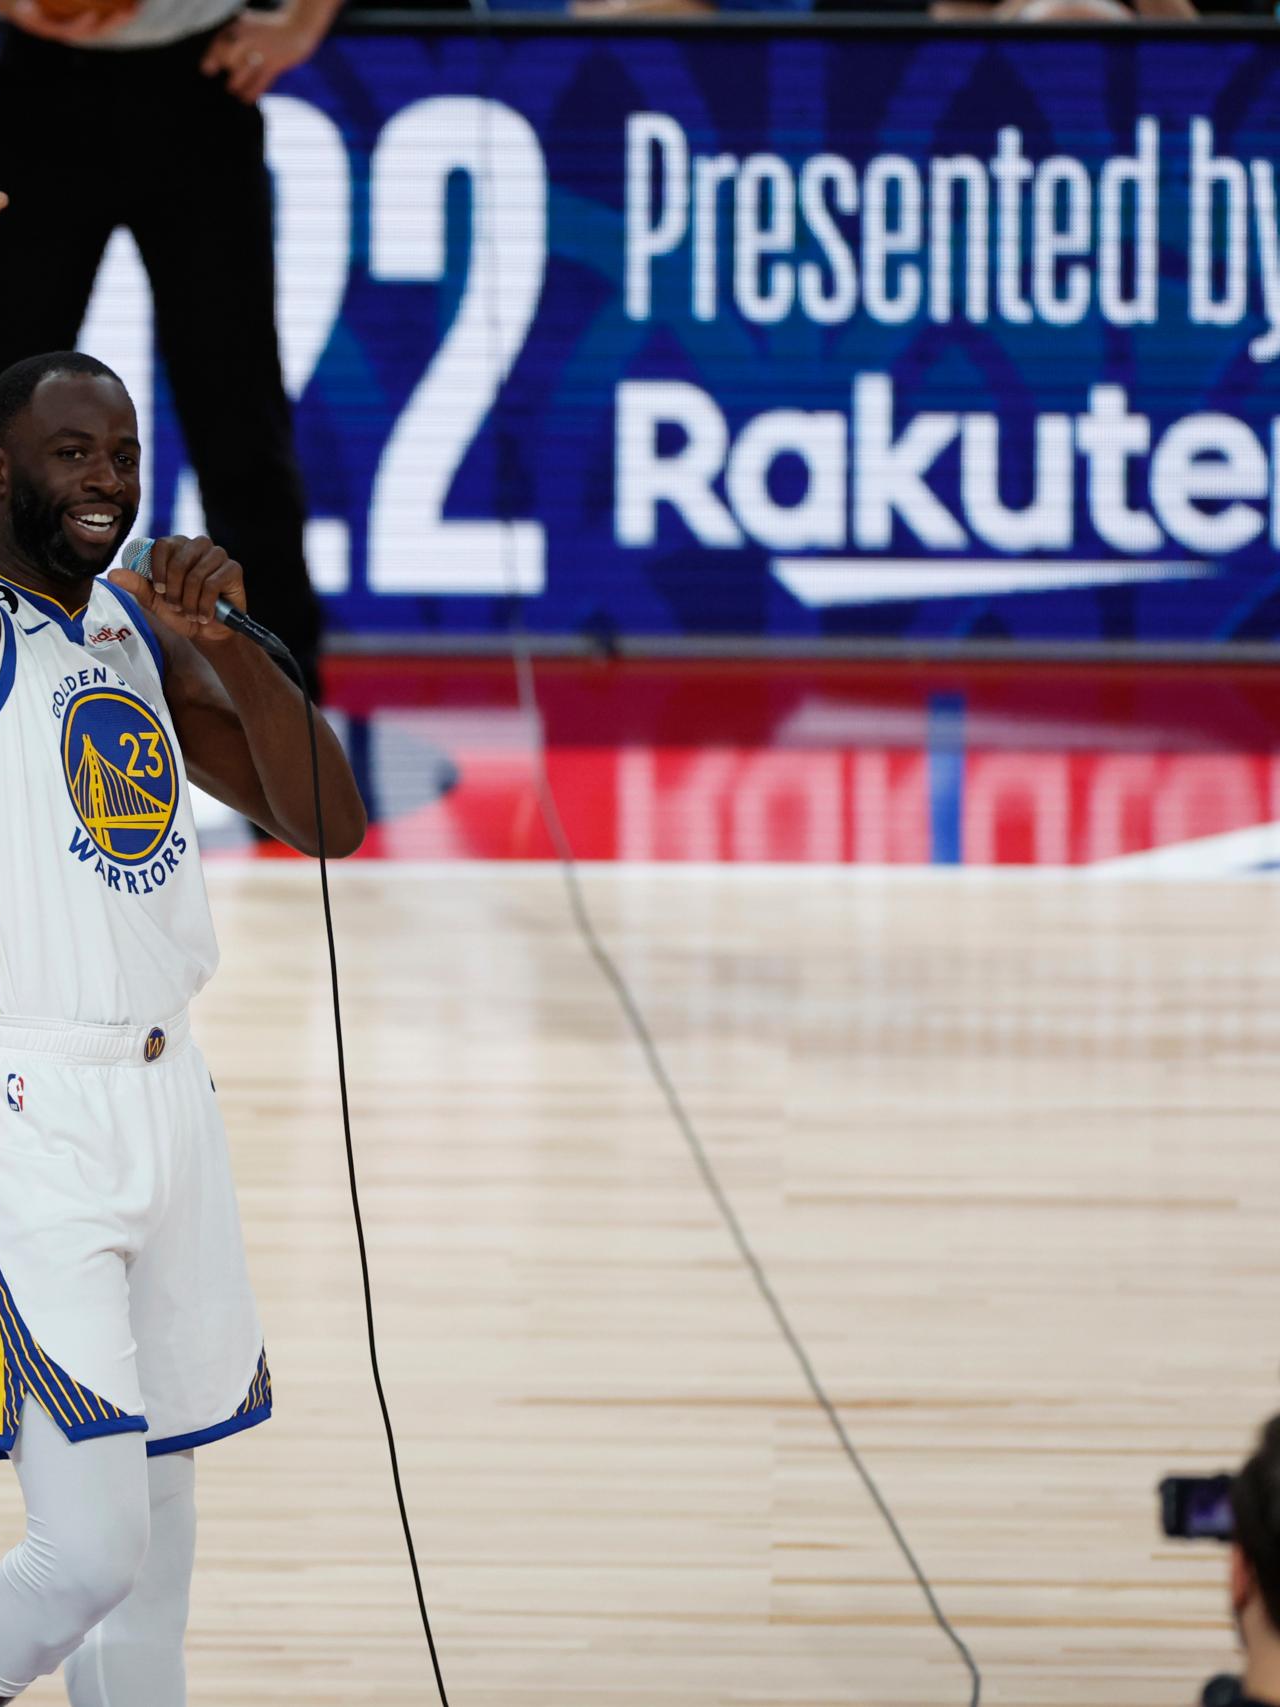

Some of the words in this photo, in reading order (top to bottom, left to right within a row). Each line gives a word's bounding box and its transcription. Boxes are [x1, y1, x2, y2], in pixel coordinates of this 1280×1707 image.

[624, 112, 1160, 325] Presented
[615, 373, 1280, 552] Rakute
[52, 667, 107, 719] GOLDEN
[119, 732, 163, 778] 23
[68, 825, 187, 895] WARRIORS
